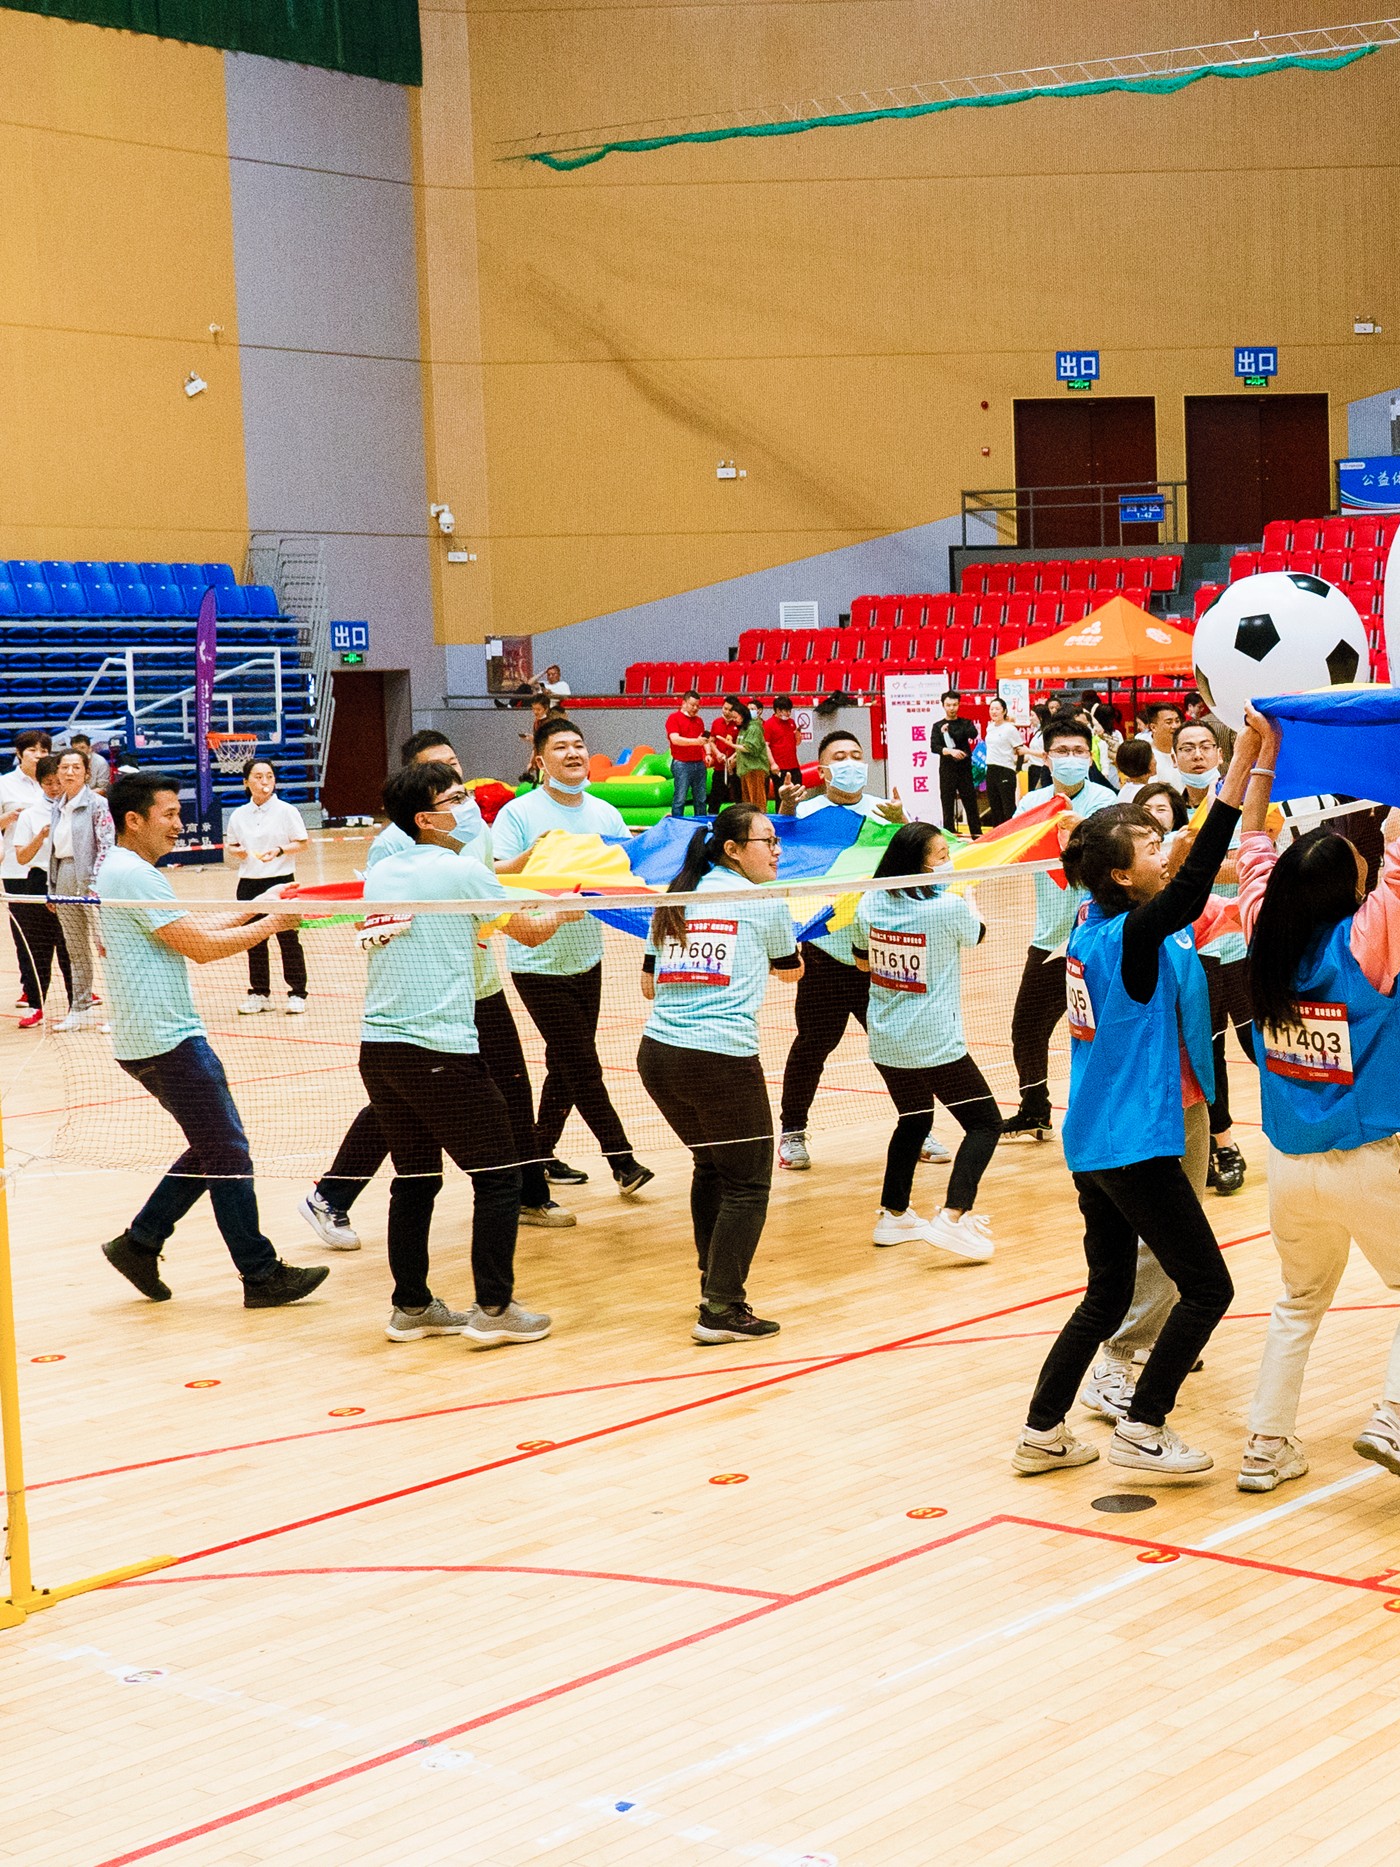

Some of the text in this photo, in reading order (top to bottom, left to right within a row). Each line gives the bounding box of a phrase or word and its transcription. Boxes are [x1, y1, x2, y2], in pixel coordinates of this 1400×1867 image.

[1060, 355, 1096, 377] 出口
[1238, 351, 1275, 373] 出口
[334, 624, 366, 648] 出口
[911, 726, 929, 792] 医疗区
[669, 942, 727, 960] T1606
[872, 948, 920, 971] T1610
